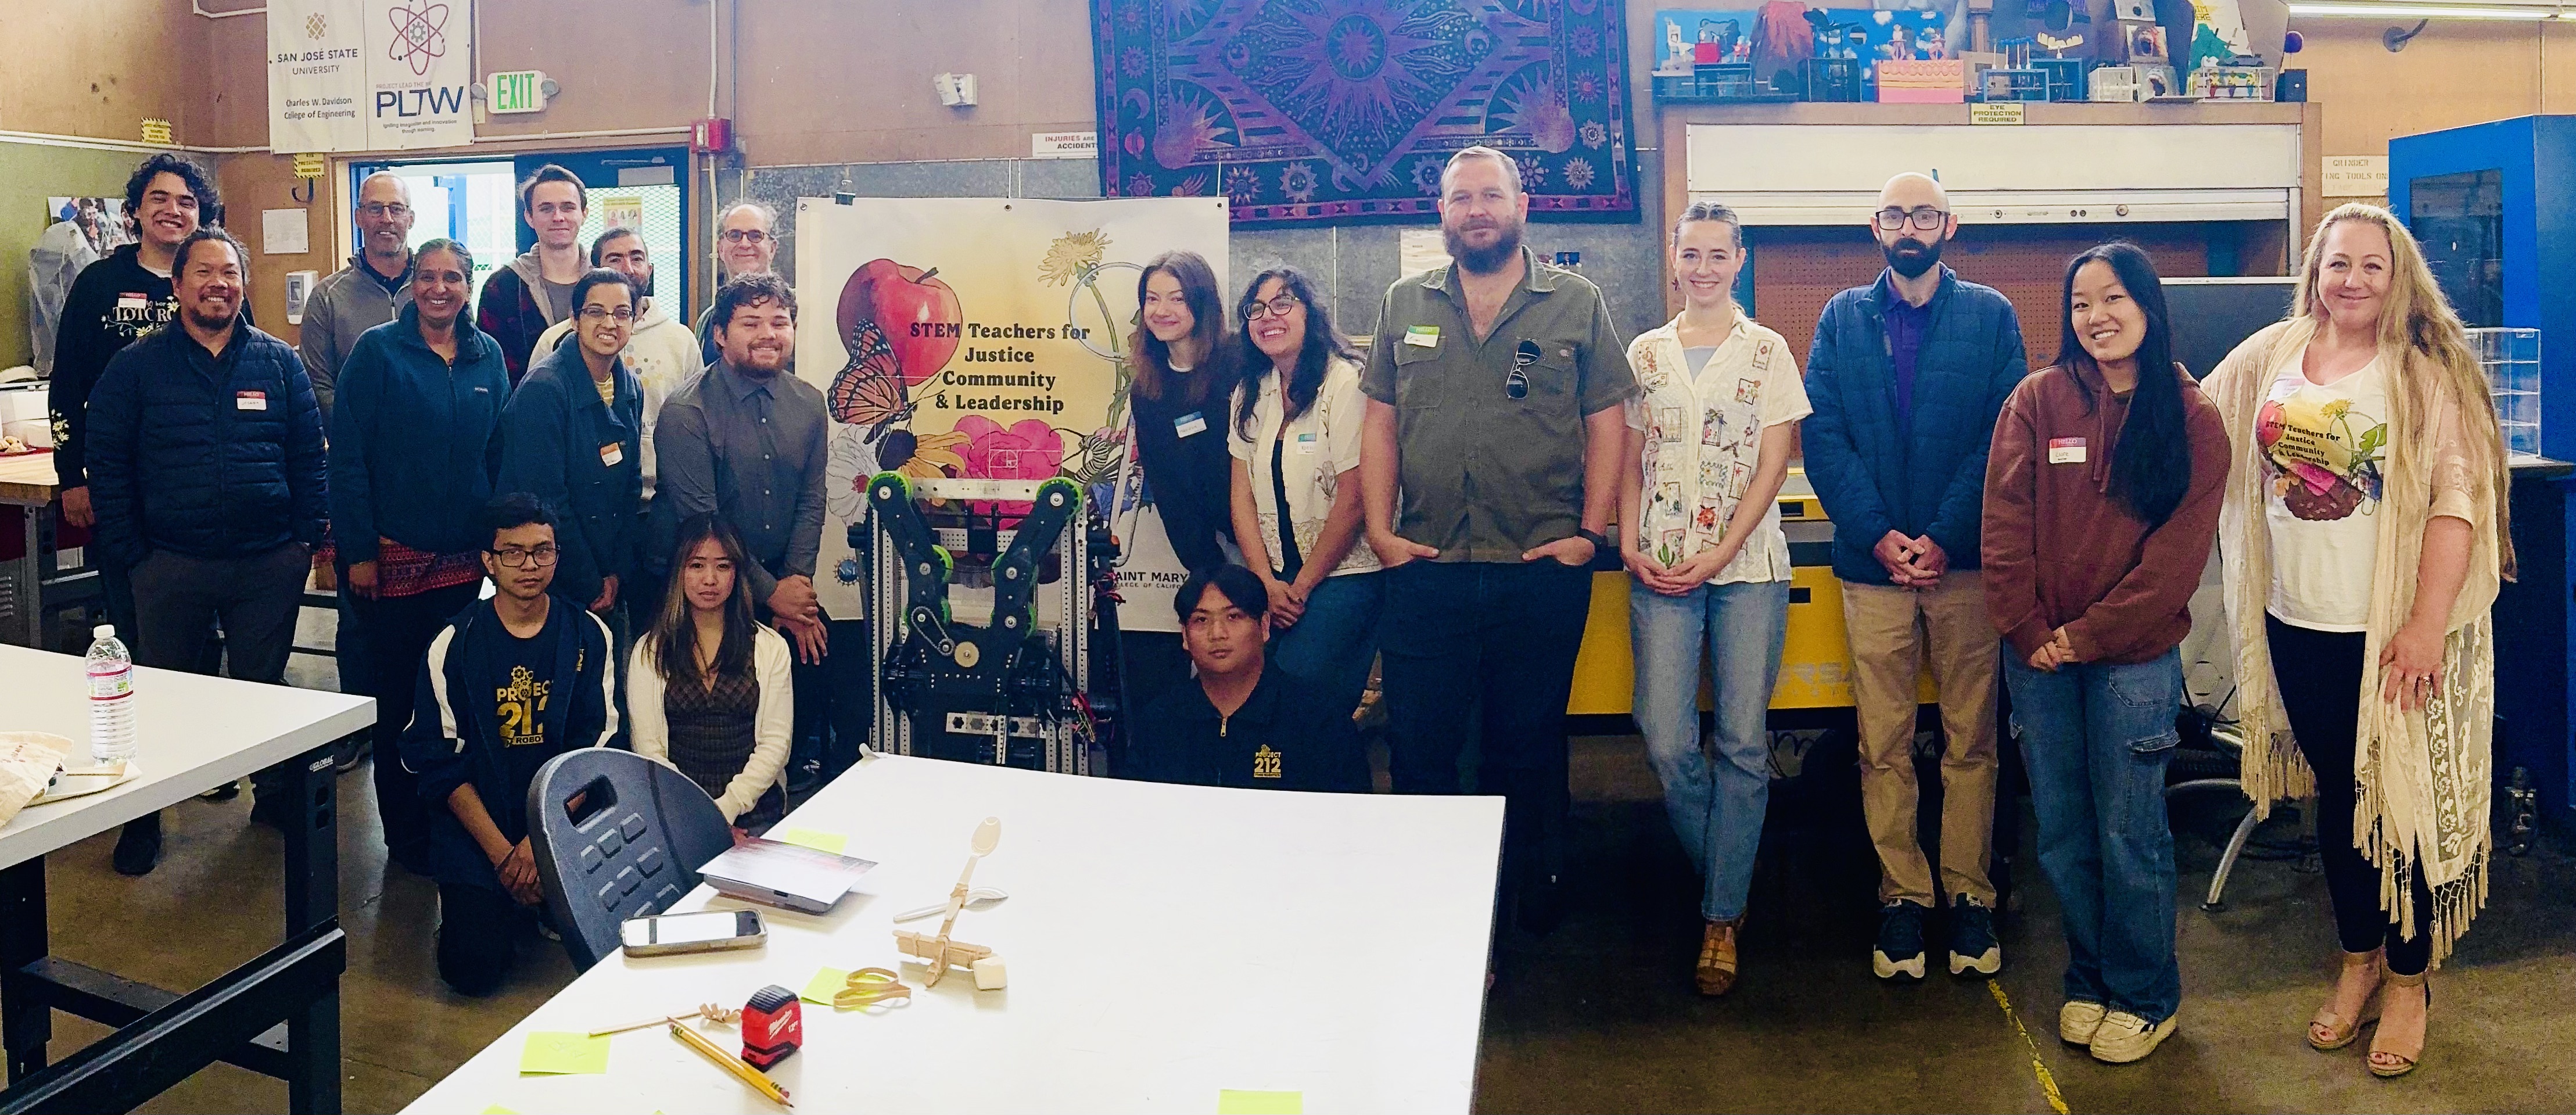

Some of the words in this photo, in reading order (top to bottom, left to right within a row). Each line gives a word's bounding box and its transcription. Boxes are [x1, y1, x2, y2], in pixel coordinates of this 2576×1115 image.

[278, 53, 297, 63] SAN
[301, 48, 324, 62] JOSÉ
[328, 48, 358, 59] STATE
[292, 65, 340, 75] UNIVERSITY
[497, 73, 534, 109] EXIT
[286, 98, 310, 107] Charles
[322, 97, 352, 105] Davidson
[376, 86, 464, 117] PLTW
[284, 110, 306, 120] College
[317, 109, 356, 120] Engineering
[910, 322, 960, 338] STEM
[968, 323, 1055, 339] Teachers
[1062, 324, 1090, 339] for
[964, 346, 1035, 363] Justice
[942, 370, 1056, 391] Community
[935, 394, 949, 409] &
[956, 395, 1064, 414] Leadership
[2266, 421, 2286, 430] STEM
[2288, 425, 2324, 439] Teachers
[2326, 432, 2341, 441] for
[2286, 434, 2315, 445] Justice
[2278, 442, 2325, 457] Community
[1254, 758, 1281, 773] 212
